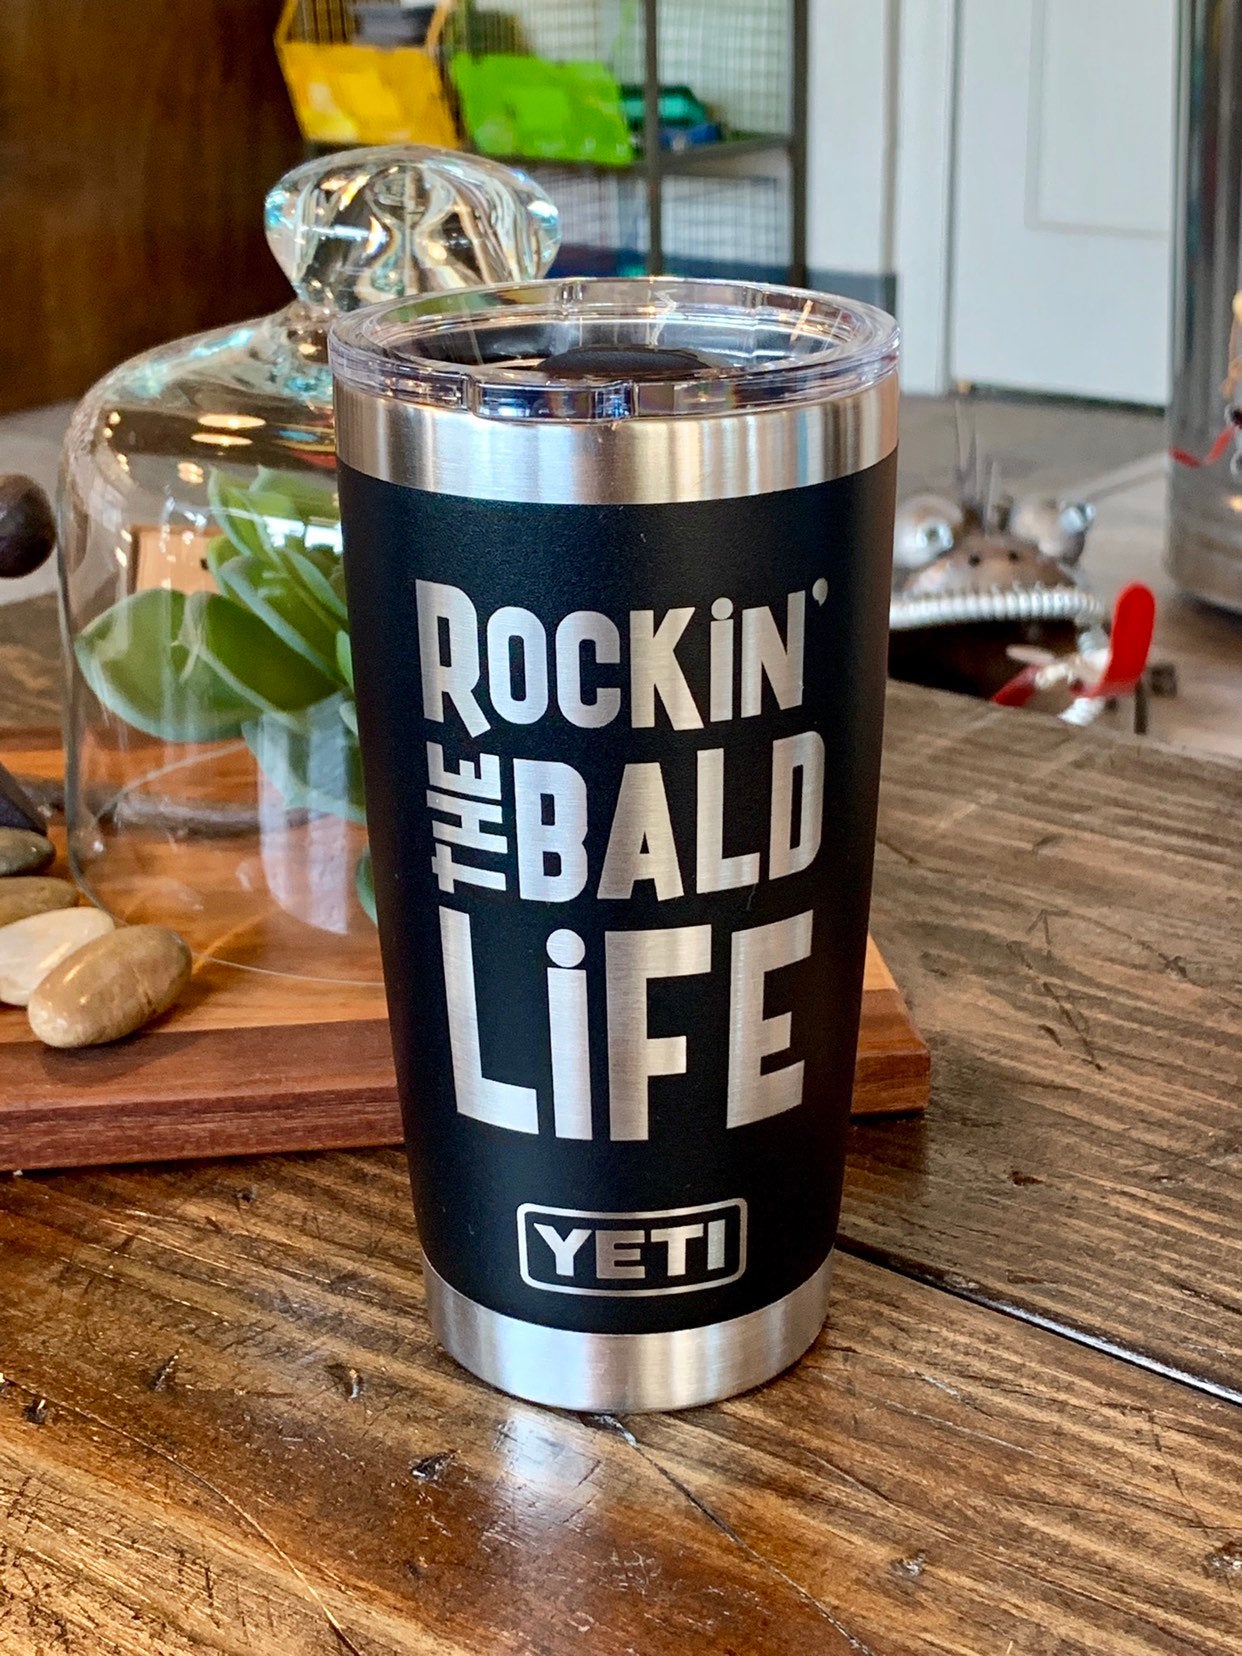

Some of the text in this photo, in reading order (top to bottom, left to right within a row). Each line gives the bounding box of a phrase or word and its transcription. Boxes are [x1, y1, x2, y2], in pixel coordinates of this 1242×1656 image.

[426, 730, 825, 904] THE BALD
[533, 1219, 727, 1280] YETI
